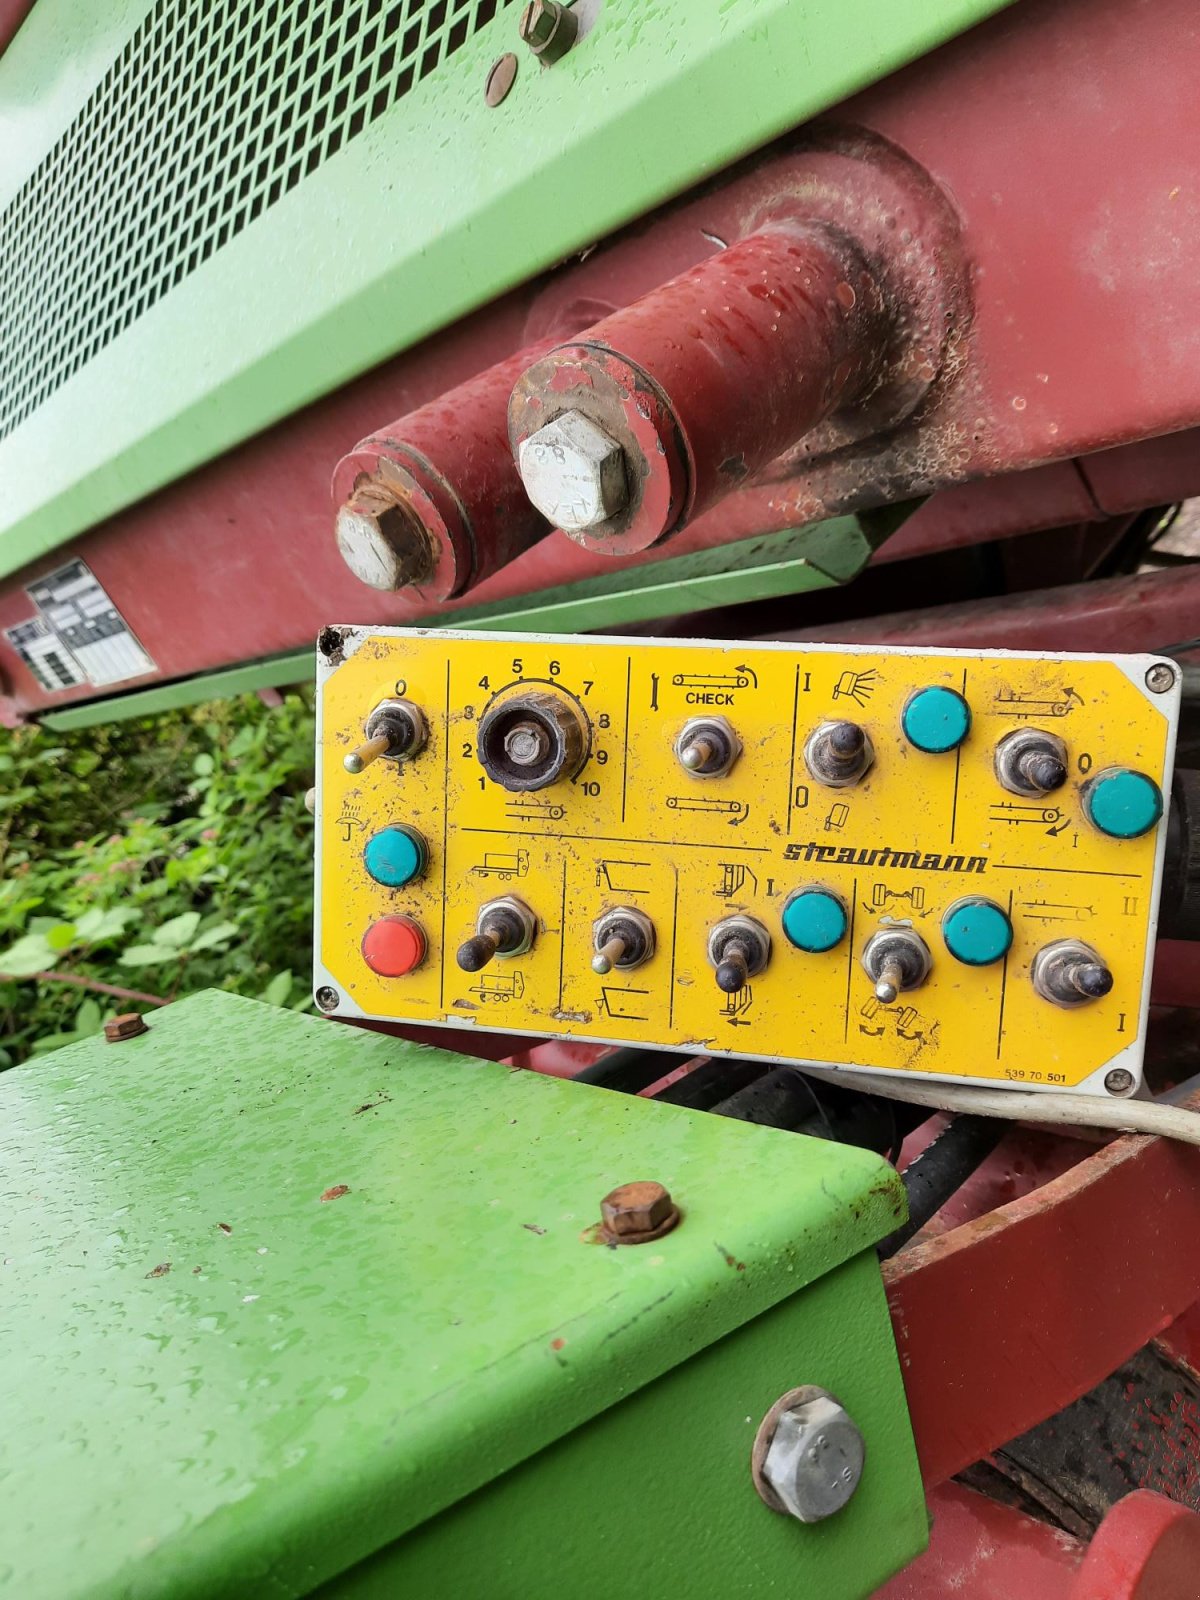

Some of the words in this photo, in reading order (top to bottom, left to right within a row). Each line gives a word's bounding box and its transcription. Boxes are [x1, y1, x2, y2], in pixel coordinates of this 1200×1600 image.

[512, 658, 523, 674] 5
[549, 660, 561, 676] 6
[395, 679, 407, 696] 0
[478, 675, 490, 690] 4
[583, 680, 594, 696] 7
[685, 692, 735, 705] CHECK
[463, 705, 474, 720] 3
[598, 713, 611, 729] 8
[462, 743, 473, 758] 2
[596, 750, 609, 765] 9
[478, 776, 486, 790] 1
[580, 781, 601, 797] 10
[795, 785, 809, 808] 0
[783, 842, 988, 873] strautmann
[1005, 1069, 1025, 1079] 539
[1030, 1071, 1042, 1080] 70
[1047, 1073, 1066, 1082] 501
